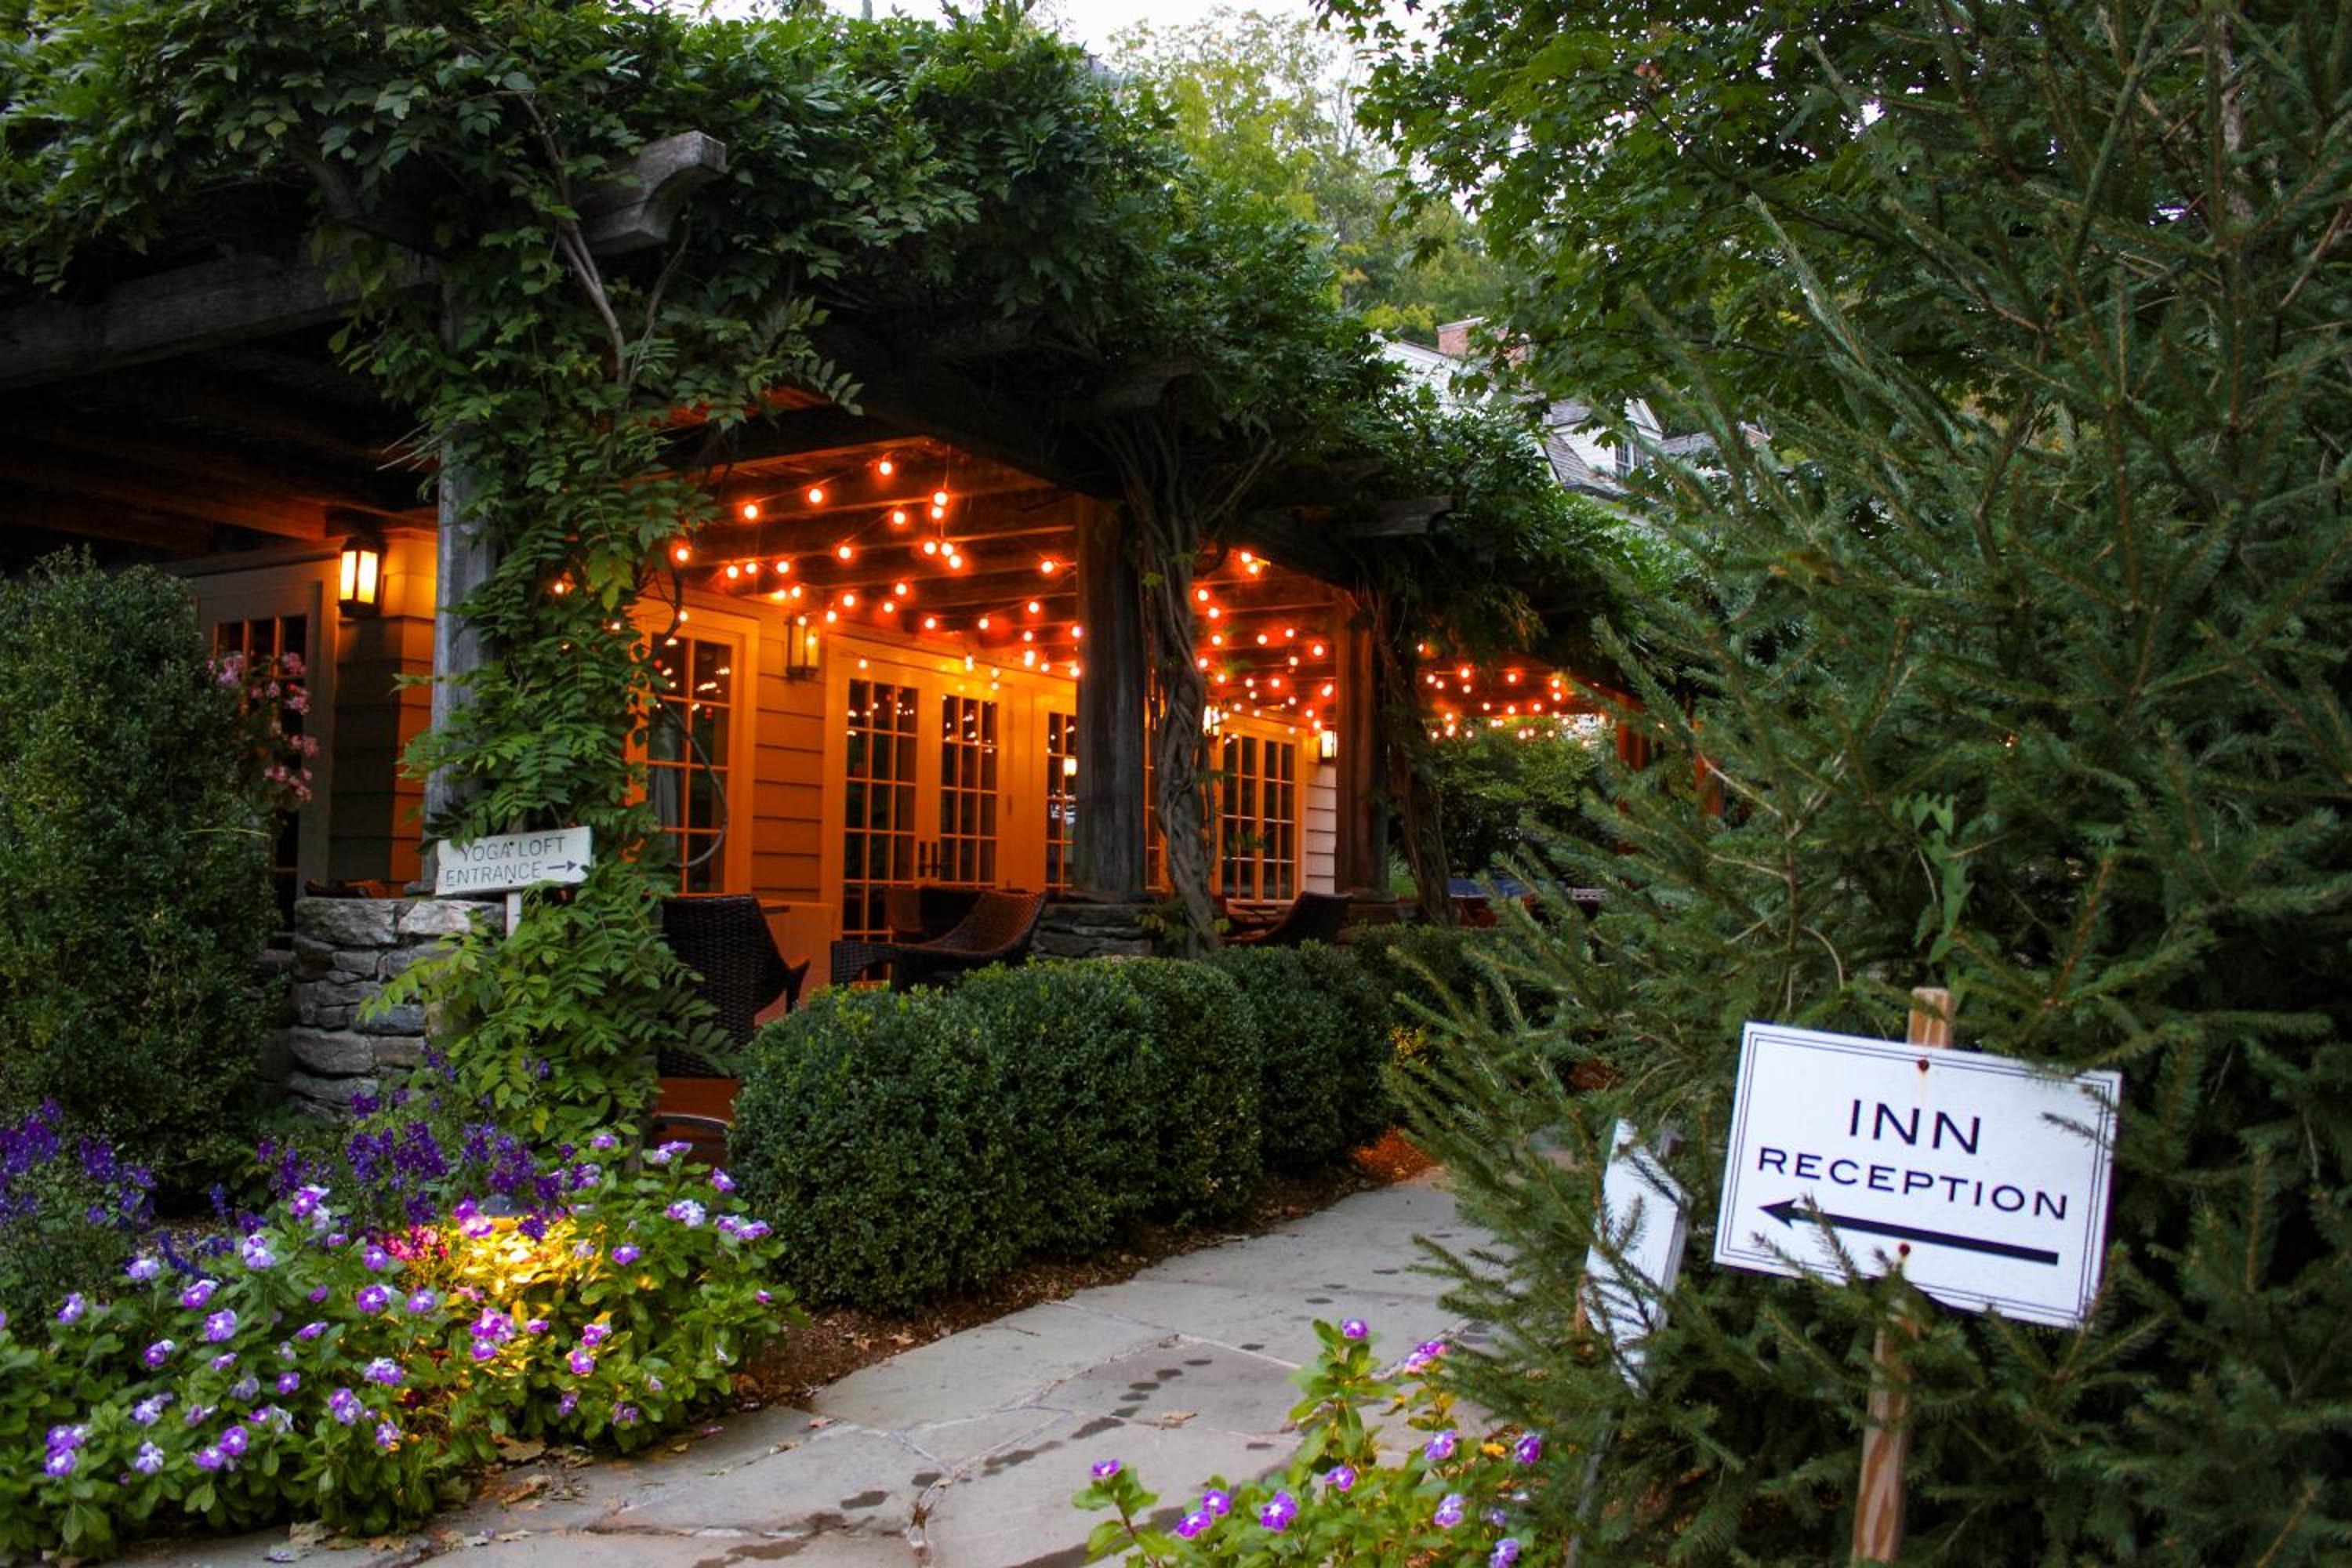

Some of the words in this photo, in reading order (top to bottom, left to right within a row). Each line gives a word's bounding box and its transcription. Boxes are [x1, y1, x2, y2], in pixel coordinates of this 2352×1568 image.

[460, 842, 511, 862] YOGA
[517, 836, 565, 858] LOFT
[445, 861, 543, 887] ENTRANCE
[1849, 1098, 1980, 1155] INN
[1757, 1146, 2067, 1221] RECEPTION
